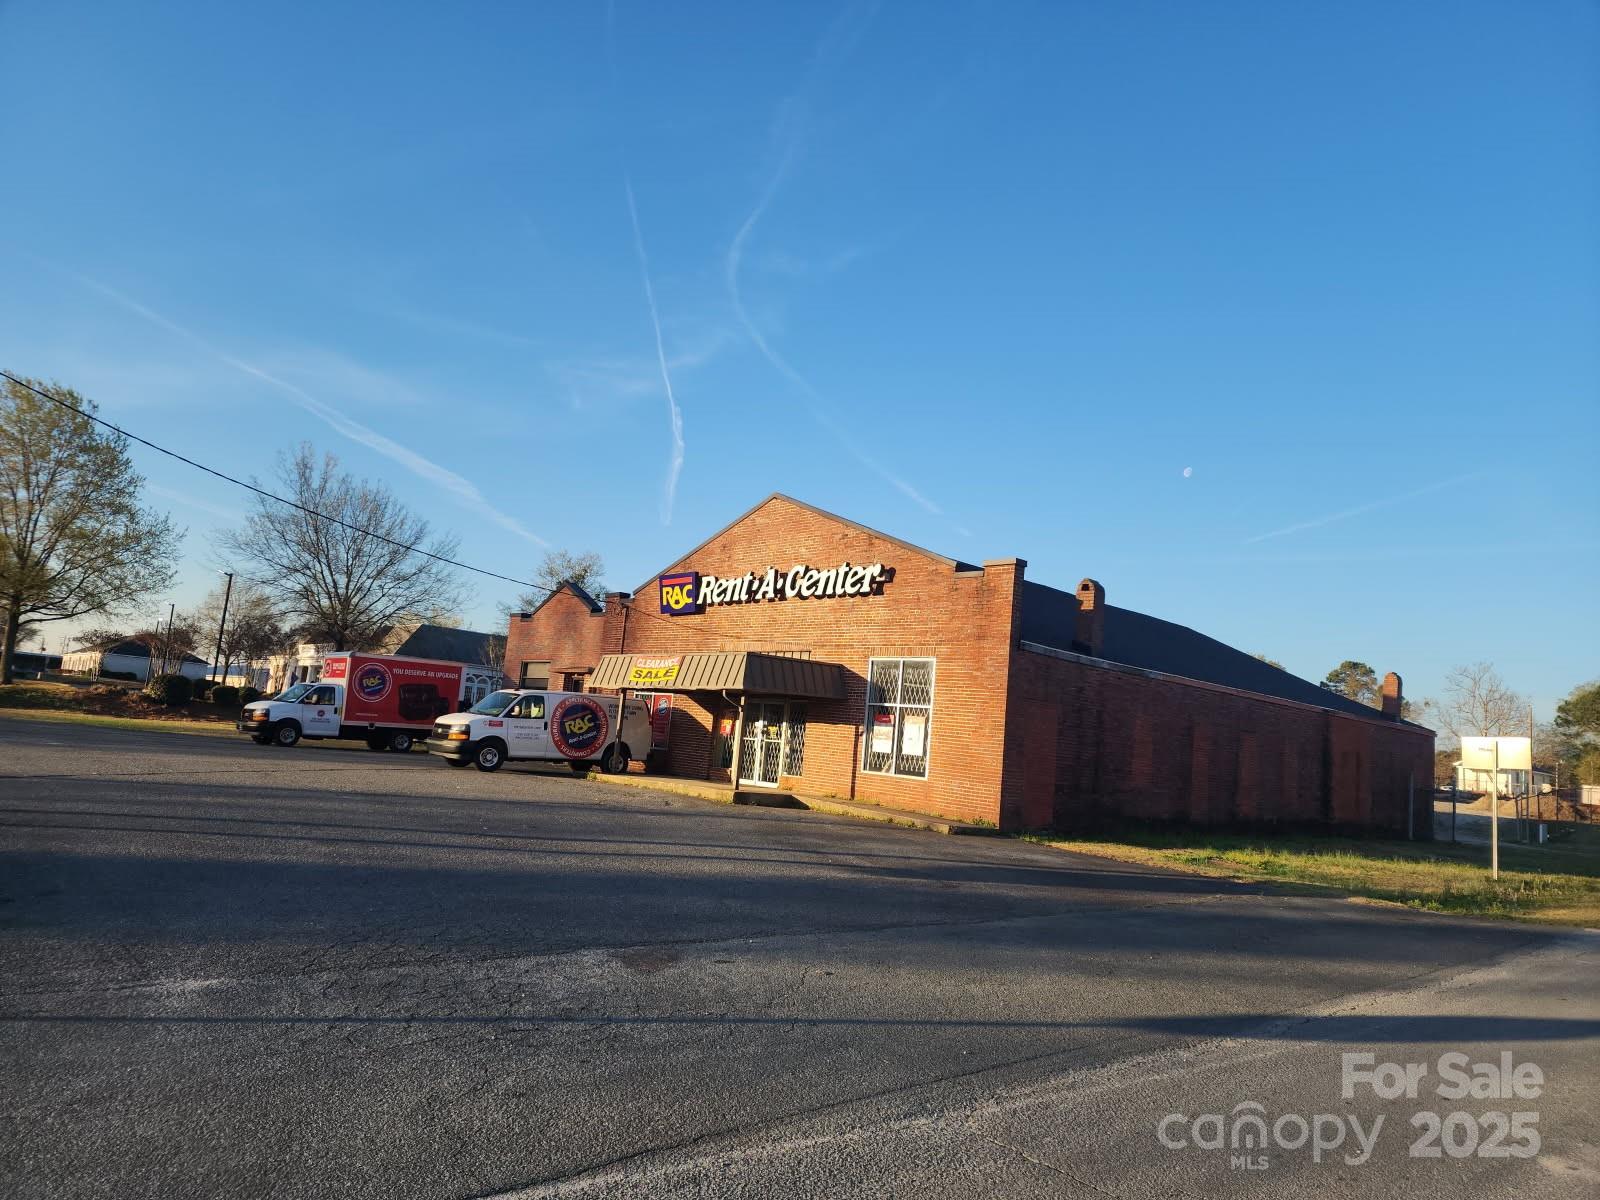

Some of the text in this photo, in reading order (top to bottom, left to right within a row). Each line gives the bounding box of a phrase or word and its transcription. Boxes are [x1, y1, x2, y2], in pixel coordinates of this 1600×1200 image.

[661, 584, 693, 609] RAC
[404, 669, 427, 677] DESERVE
[435, 672, 459, 680] UPGRADE
[633, 668, 675, 679] SALE
[564, 714, 594, 734] RAC
